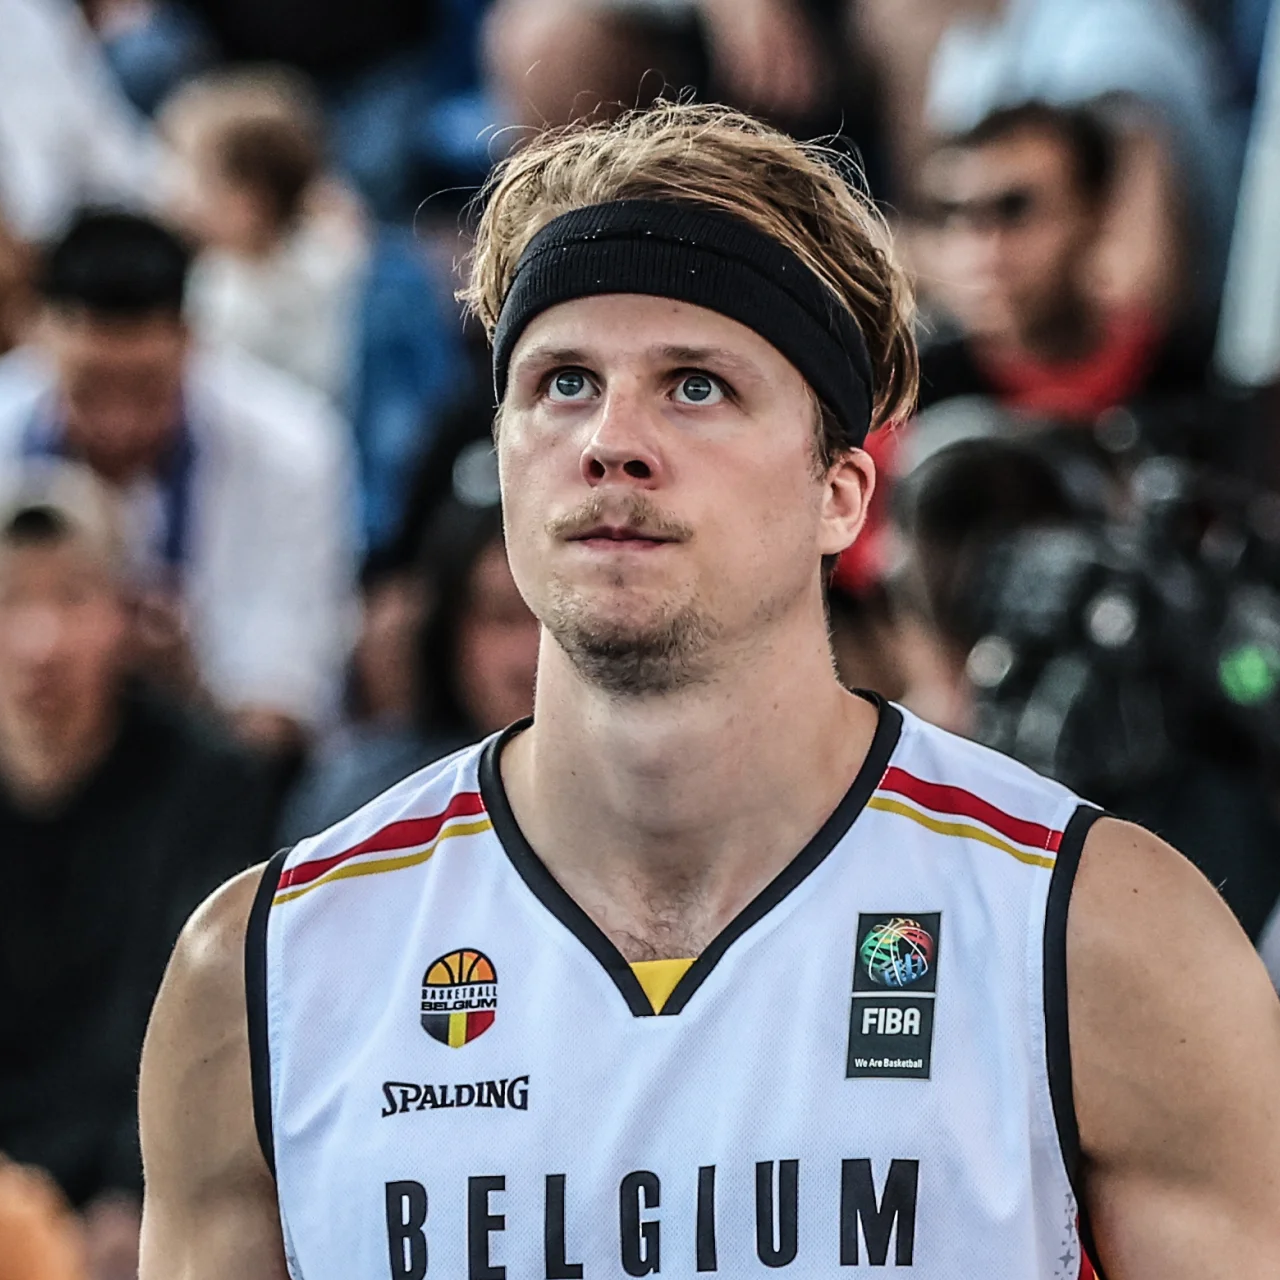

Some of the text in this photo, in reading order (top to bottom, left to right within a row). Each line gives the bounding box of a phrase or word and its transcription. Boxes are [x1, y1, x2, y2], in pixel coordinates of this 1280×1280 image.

[421, 986, 497, 1000] BASKETBALL
[421, 998, 497, 1011] BELGIUM
[862, 1008, 920, 1035] FIBA
[854, 1058, 923, 1069] We Are Basketball
[382, 1075, 530, 1118] SPALDING
